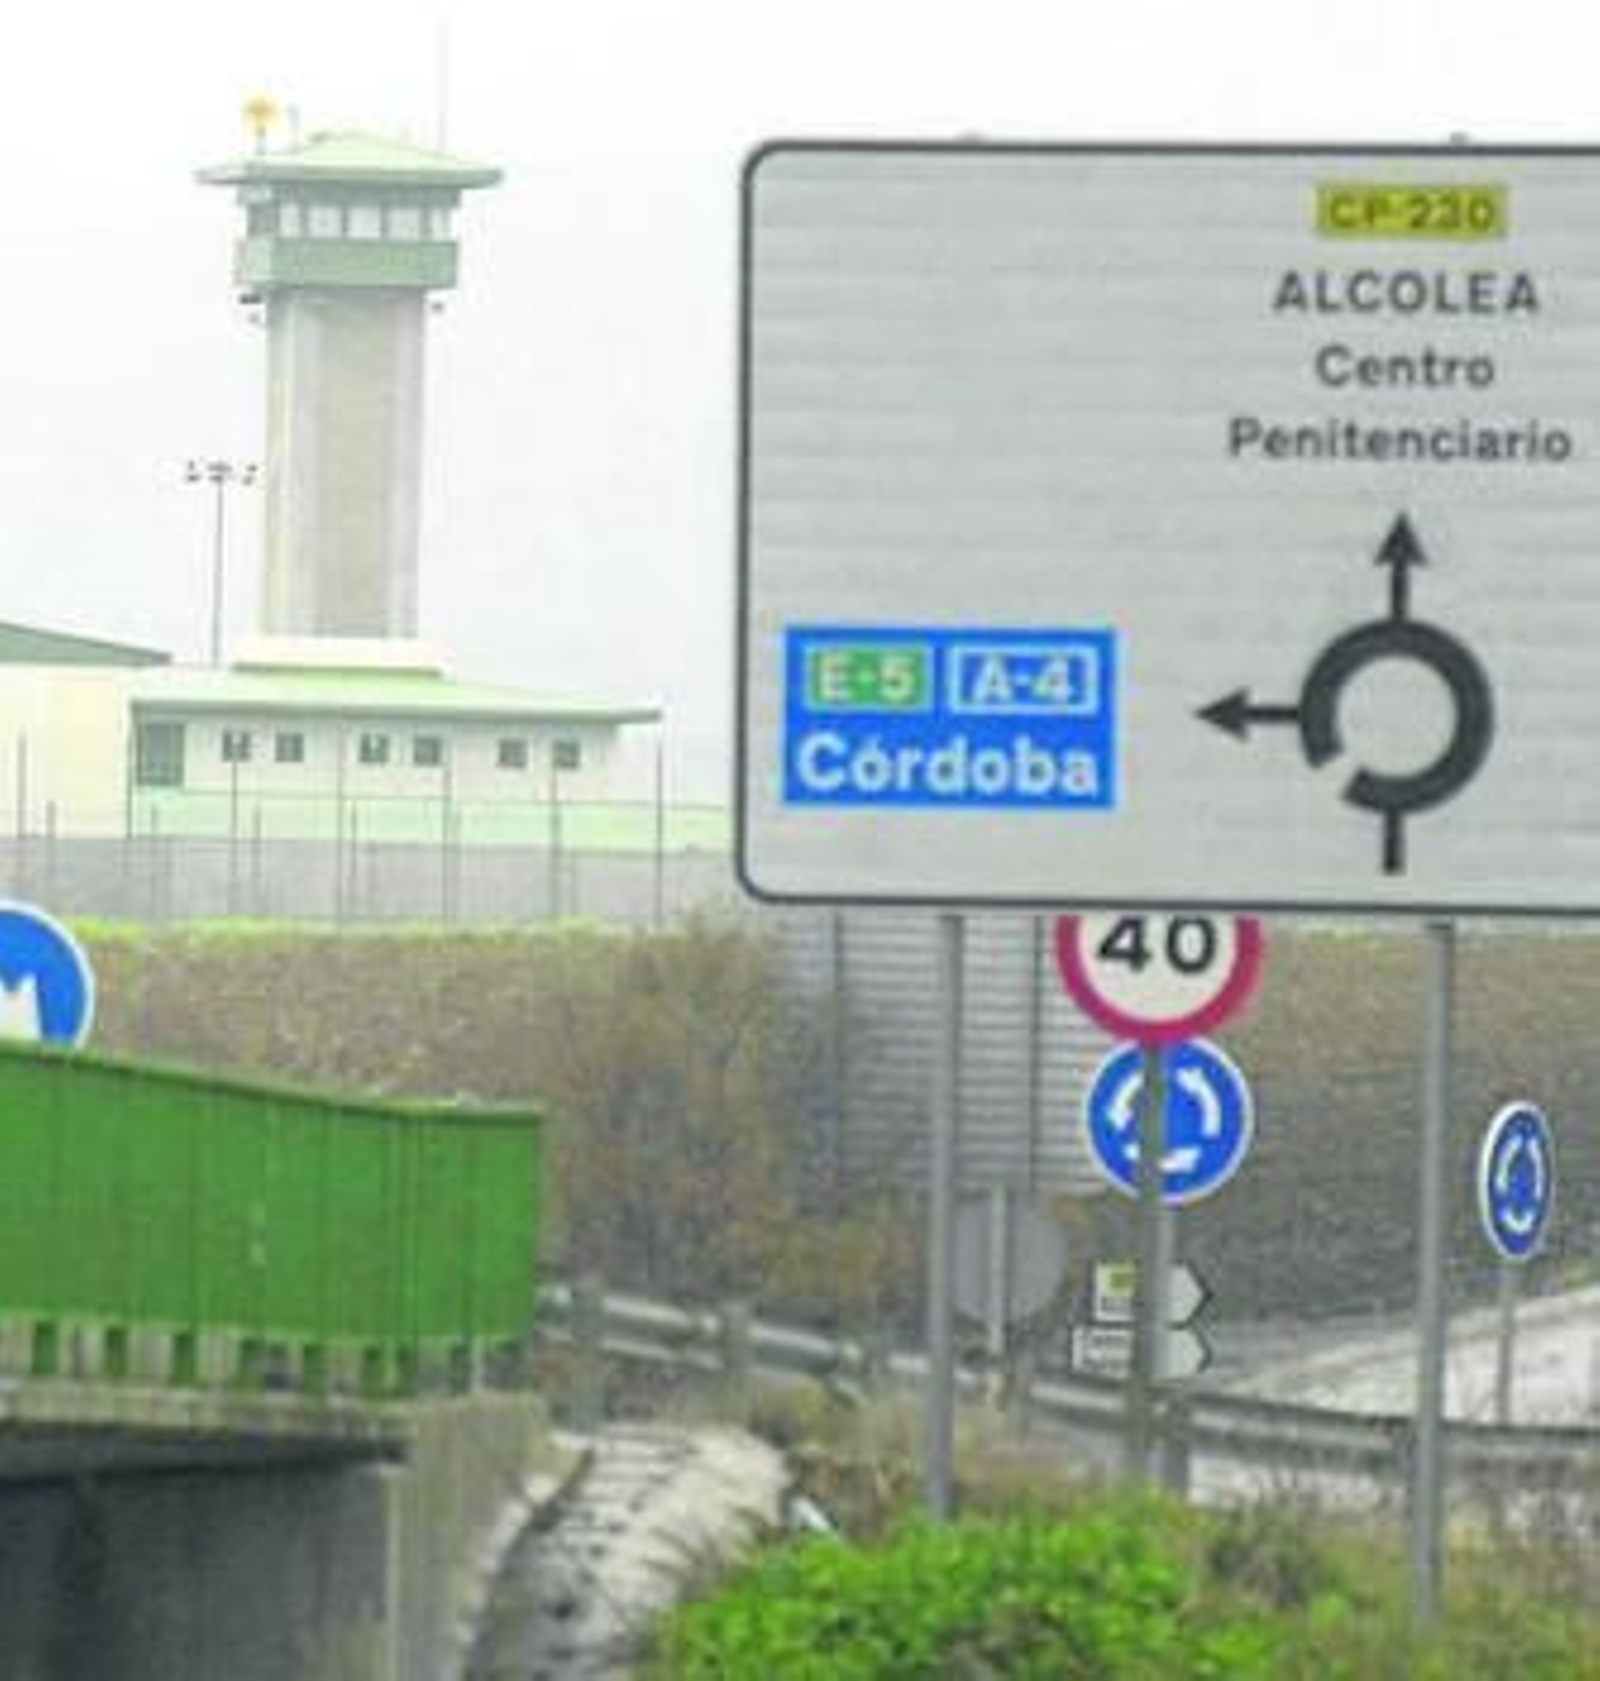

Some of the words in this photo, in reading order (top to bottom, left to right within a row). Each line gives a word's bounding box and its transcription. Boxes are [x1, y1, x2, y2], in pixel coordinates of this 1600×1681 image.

[1273, 269, 1540, 314] ALCOLEA
[1315, 345, 1495, 387] Centro
[1228, 416, 1572, 461] Penitenciario
[819, 655, 915, 700] E-5
[973, 652, 1070, 701] A-4
[798, 732, 1098, 795] Córdoba
[1098, 915, 1217, 975] 40
